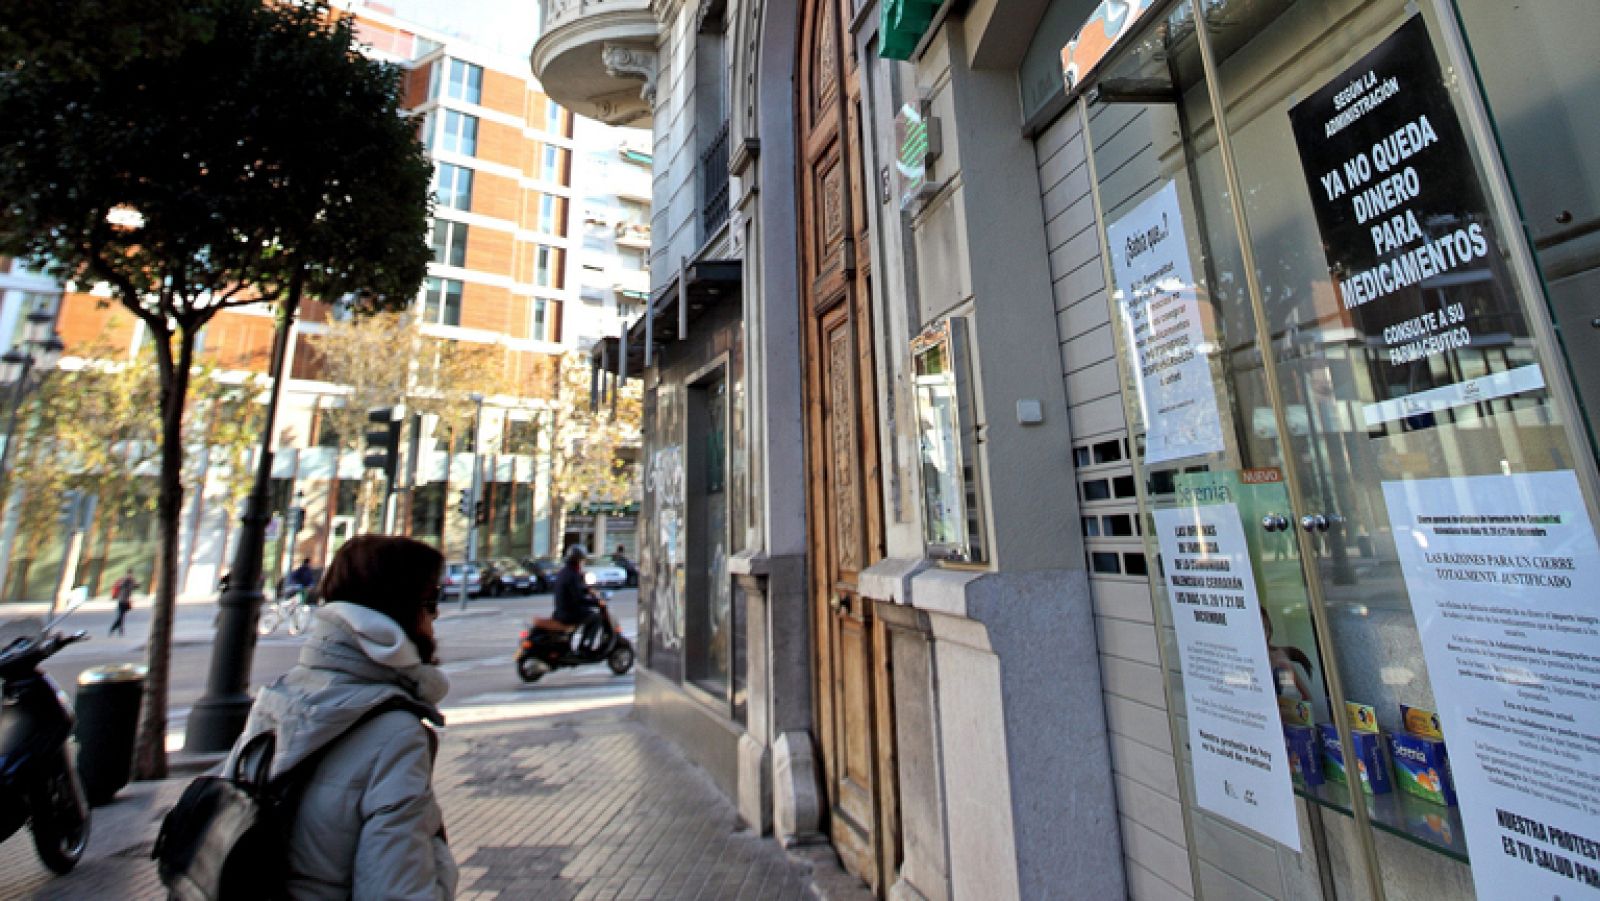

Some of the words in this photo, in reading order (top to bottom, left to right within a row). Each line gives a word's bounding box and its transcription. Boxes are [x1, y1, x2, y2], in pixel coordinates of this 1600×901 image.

[1325, 76, 1400, 139] ADMINISTRACIÓN
[1333, 77, 1364, 111] SEGÚN
[1363, 70, 1378, 94] LA
[1321, 168, 1347, 201] YA
[1344, 153, 1371, 190] NO
[1372, 114, 1438, 172] QUEDA
[1352, 166, 1420, 224] DINERO
[1371, 209, 1423, 256] PARA
[1339, 223, 1488, 310] MEDICAMENTOS
[1383, 312, 1438, 345] CONSULTE
[1438, 308, 1449, 329] A
[1448, 302, 1466, 324] SU
[1243, 470, 1278, 482] NUEVO
[1425, 552, 1442, 563] LAS
[1443, 553, 1486, 566] RAZONES
[1487, 555, 1514, 567] PARA
[1515, 556, 1532, 568] UN
[1533, 557, 1576, 570] CIERRE
[1436, 568, 1500, 583] TOTALMENTE
[1502, 572, 1572, 588] JUSTIFICADO
[1392, 739, 1427, 763] Serenia
[1495, 807, 1549, 843] NUESTRA
[1501, 834, 1518, 857] ES
[1516, 840, 1534, 864] TU
[1534, 846, 1574, 879] SALUD
